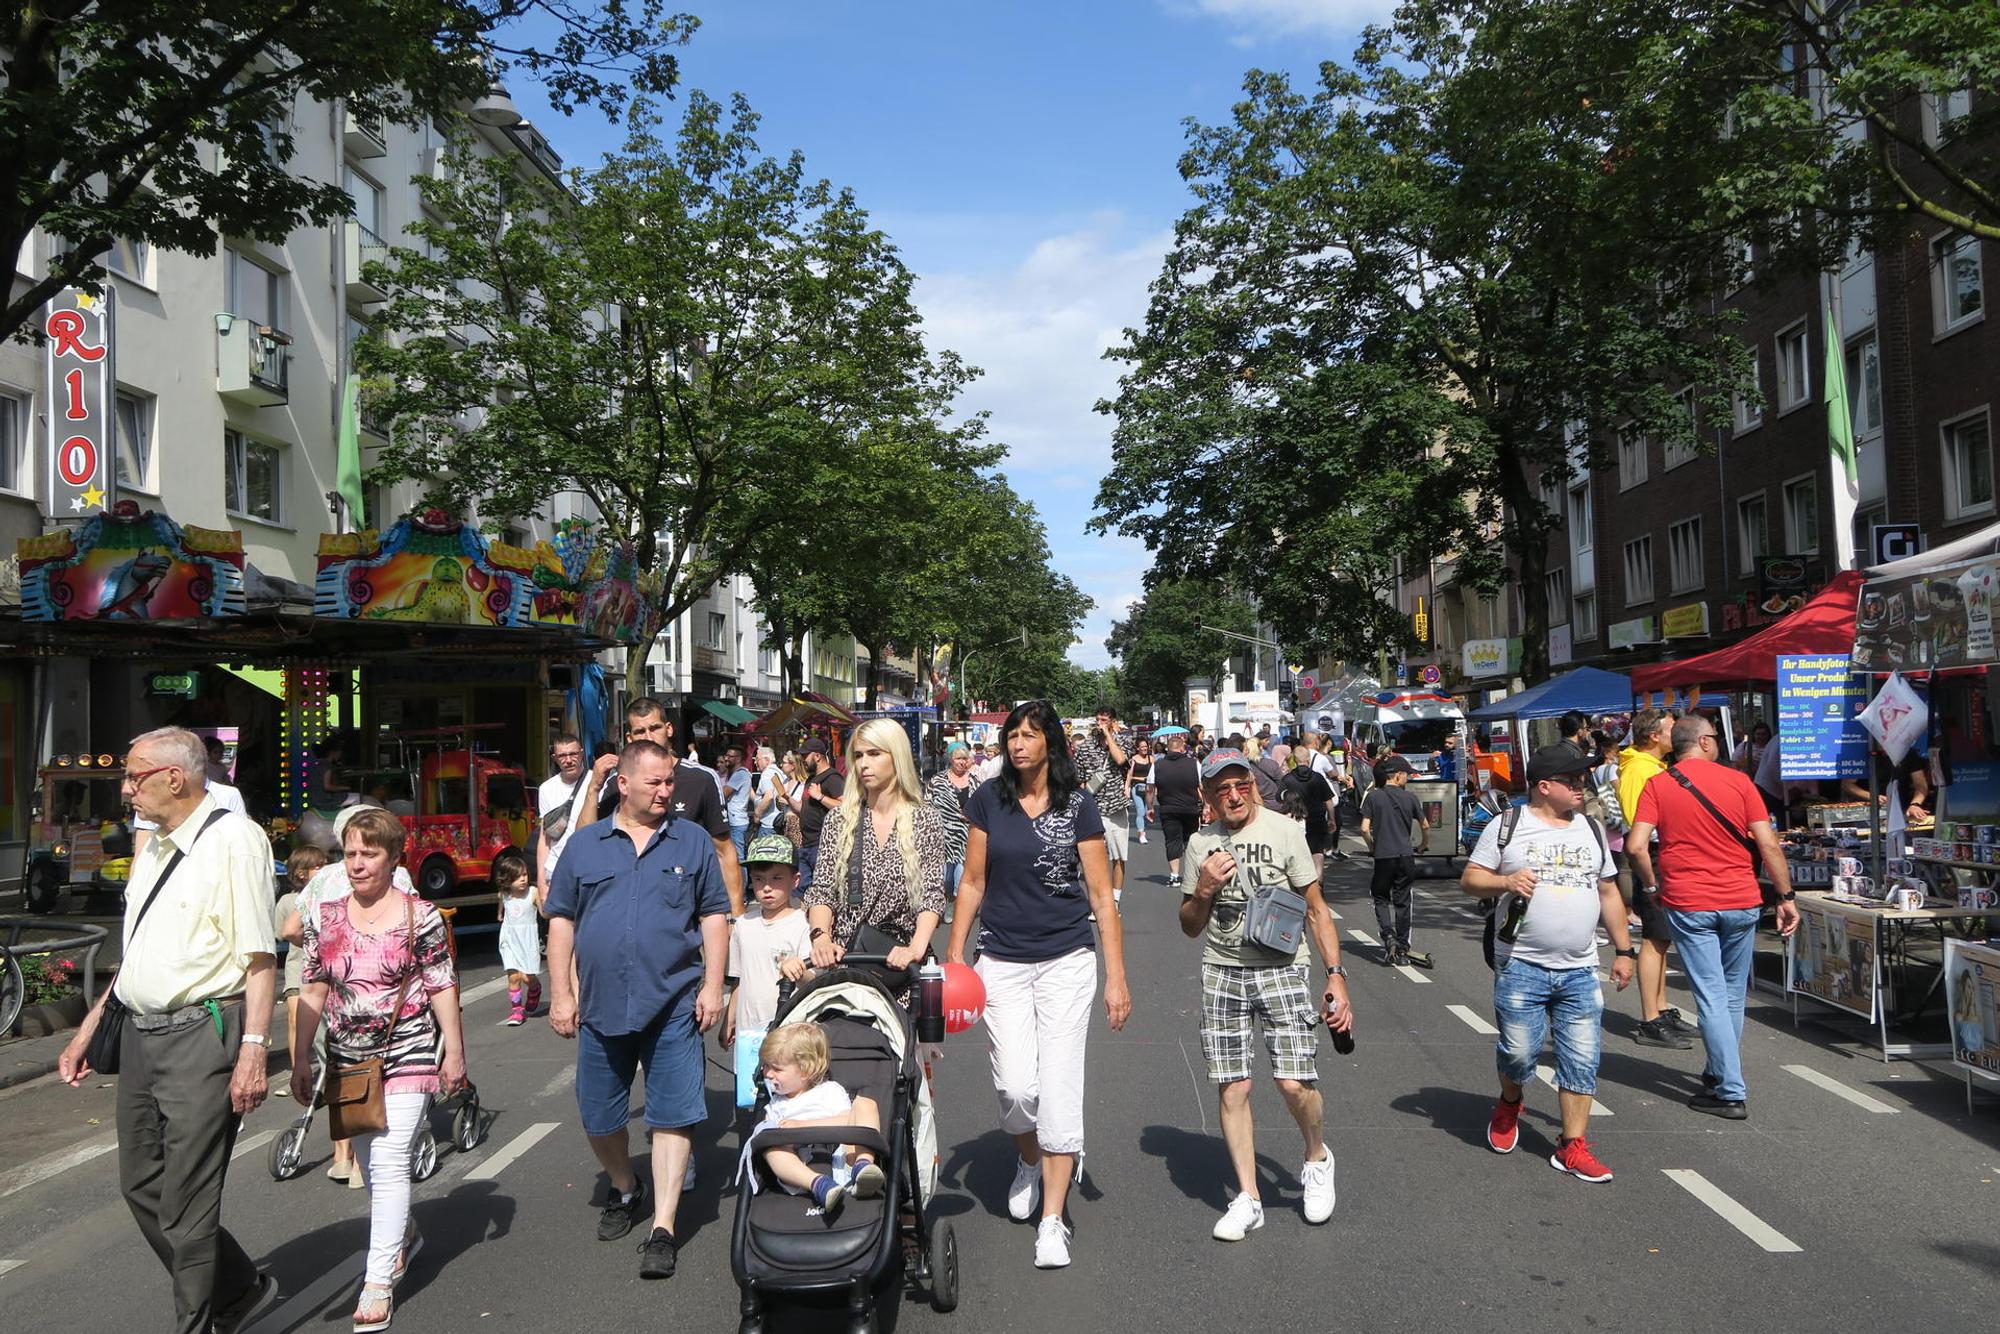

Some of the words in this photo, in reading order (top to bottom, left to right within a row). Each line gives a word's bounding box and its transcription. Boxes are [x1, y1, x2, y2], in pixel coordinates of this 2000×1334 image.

[1782, 659, 1797, 670] Ihr
[1798, 658, 1844, 670] Handyfoto
[1790, 674, 1816, 682] Unser
[1792, 687, 1830, 698] Wenigen
